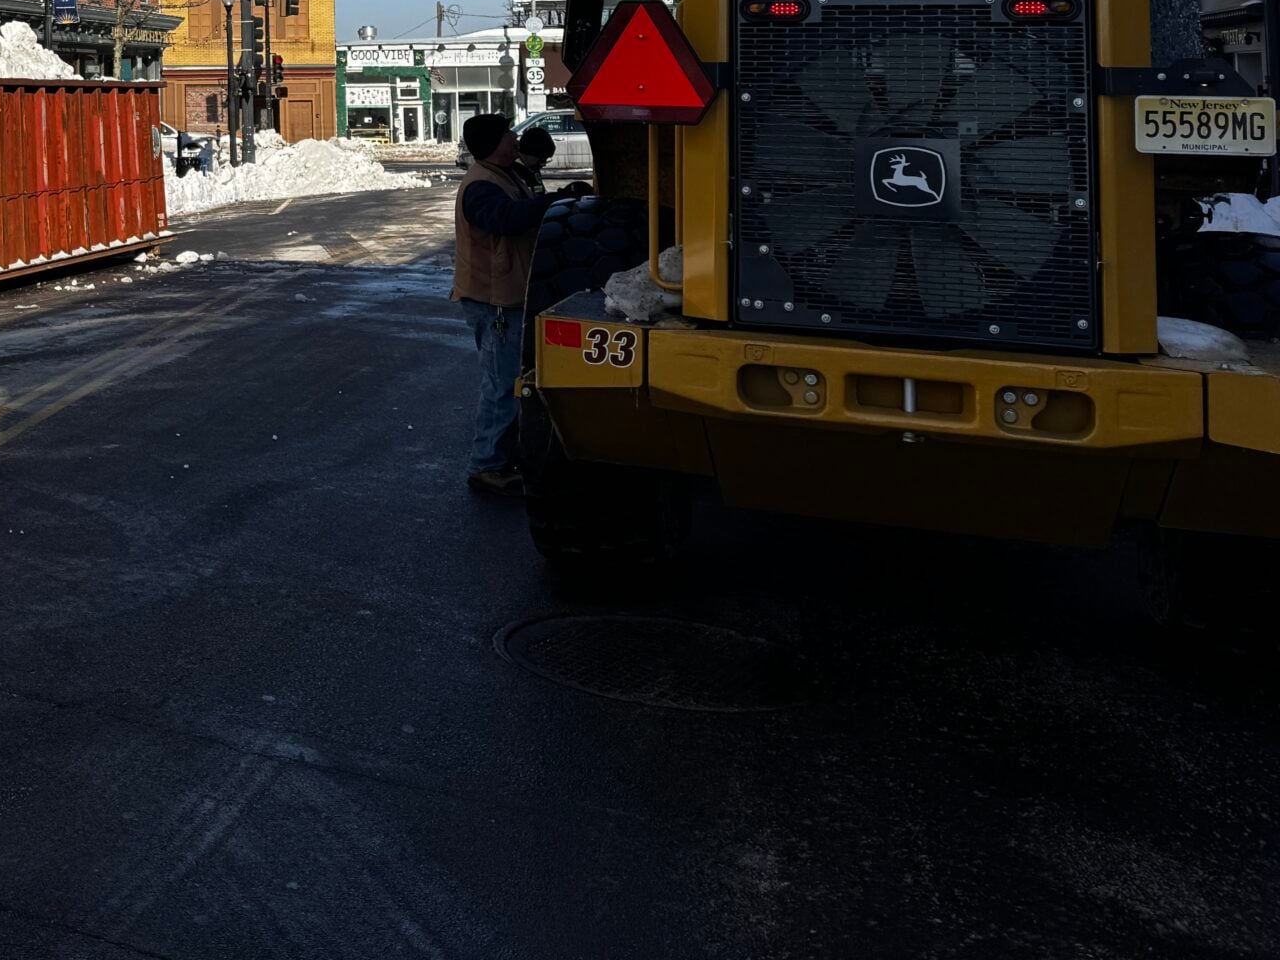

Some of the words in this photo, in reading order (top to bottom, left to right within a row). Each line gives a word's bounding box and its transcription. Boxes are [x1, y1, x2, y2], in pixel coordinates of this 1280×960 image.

[350, 50, 380, 62] GOOD
[528, 70, 543, 81] 35
[1170, 99, 1199, 110] New
[1200, 100, 1240, 112] Jersey
[1144, 110, 1266, 141] 55589MG
[1181, 143, 1229, 151] MUNICIPAL
[582, 327, 638, 369] 33
